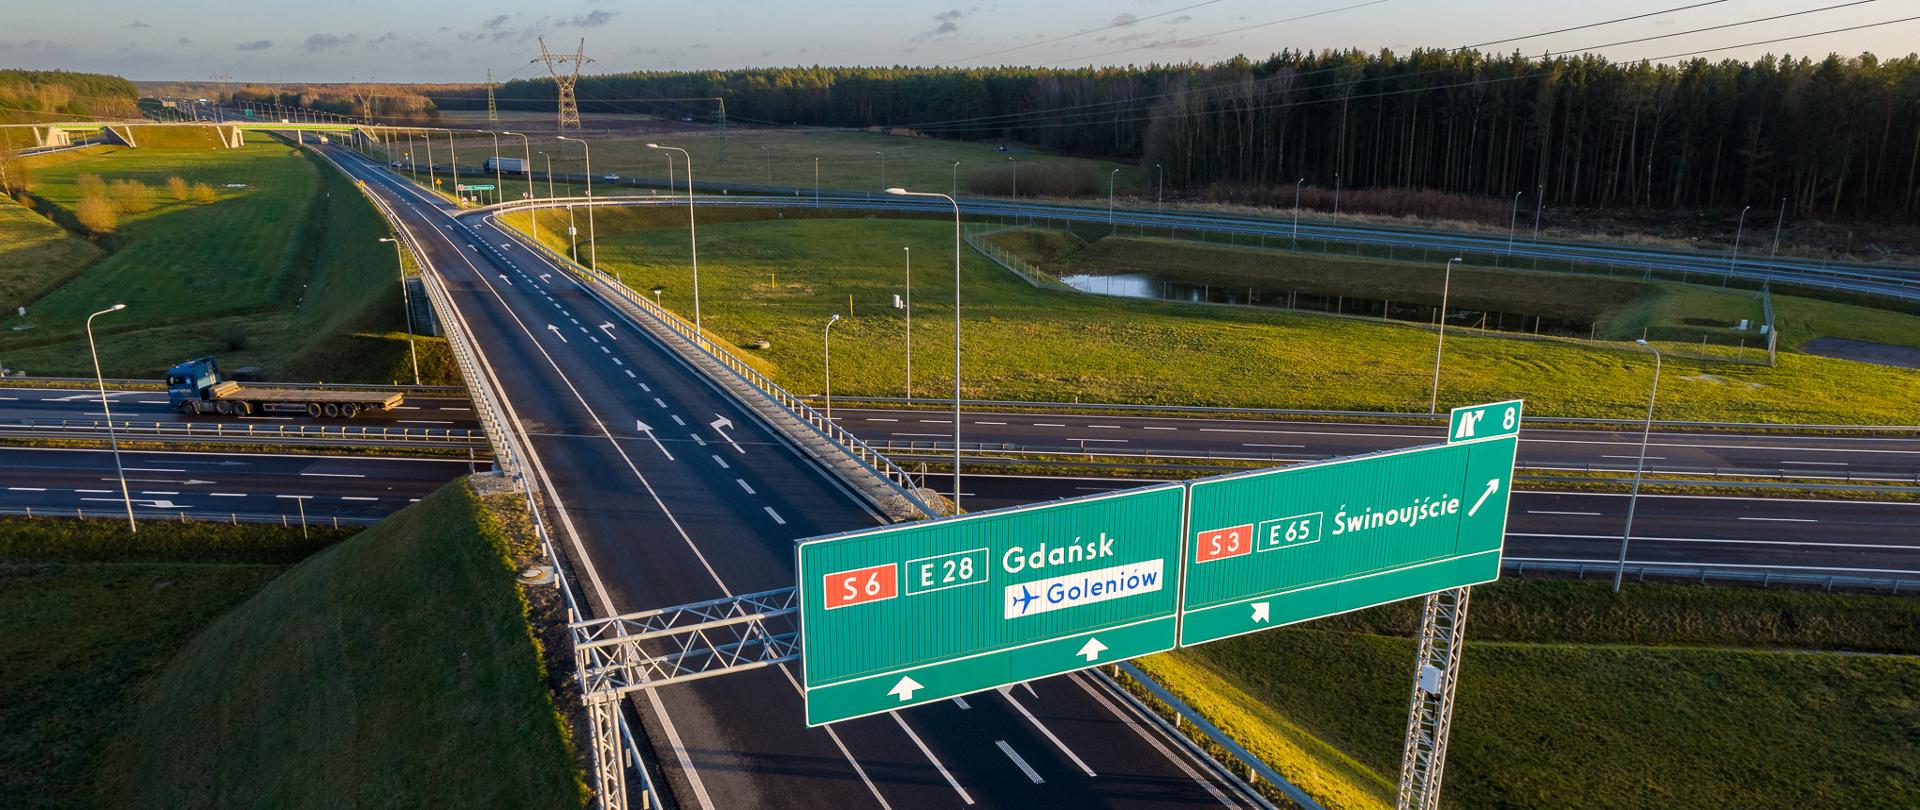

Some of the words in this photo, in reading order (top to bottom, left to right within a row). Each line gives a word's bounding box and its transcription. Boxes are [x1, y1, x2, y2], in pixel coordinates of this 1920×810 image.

[1502, 406, 1516, 431] 8
[1332, 493, 1460, 535] Świnoujście
[1209, 534, 1222, 555] S
[1227, 531, 1239, 552] 3
[1269, 524, 1281, 546] E
[1285, 519, 1310, 542] 65
[1002, 532, 1115, 574] Gdańsk
[842, 576, 858, 600] S
[864, 571, 881, 596] 6
[921, 563, 934, 587] E
[942, 556, 974, 583] 28
[1047, 568, 1158, 604] Goleniów
